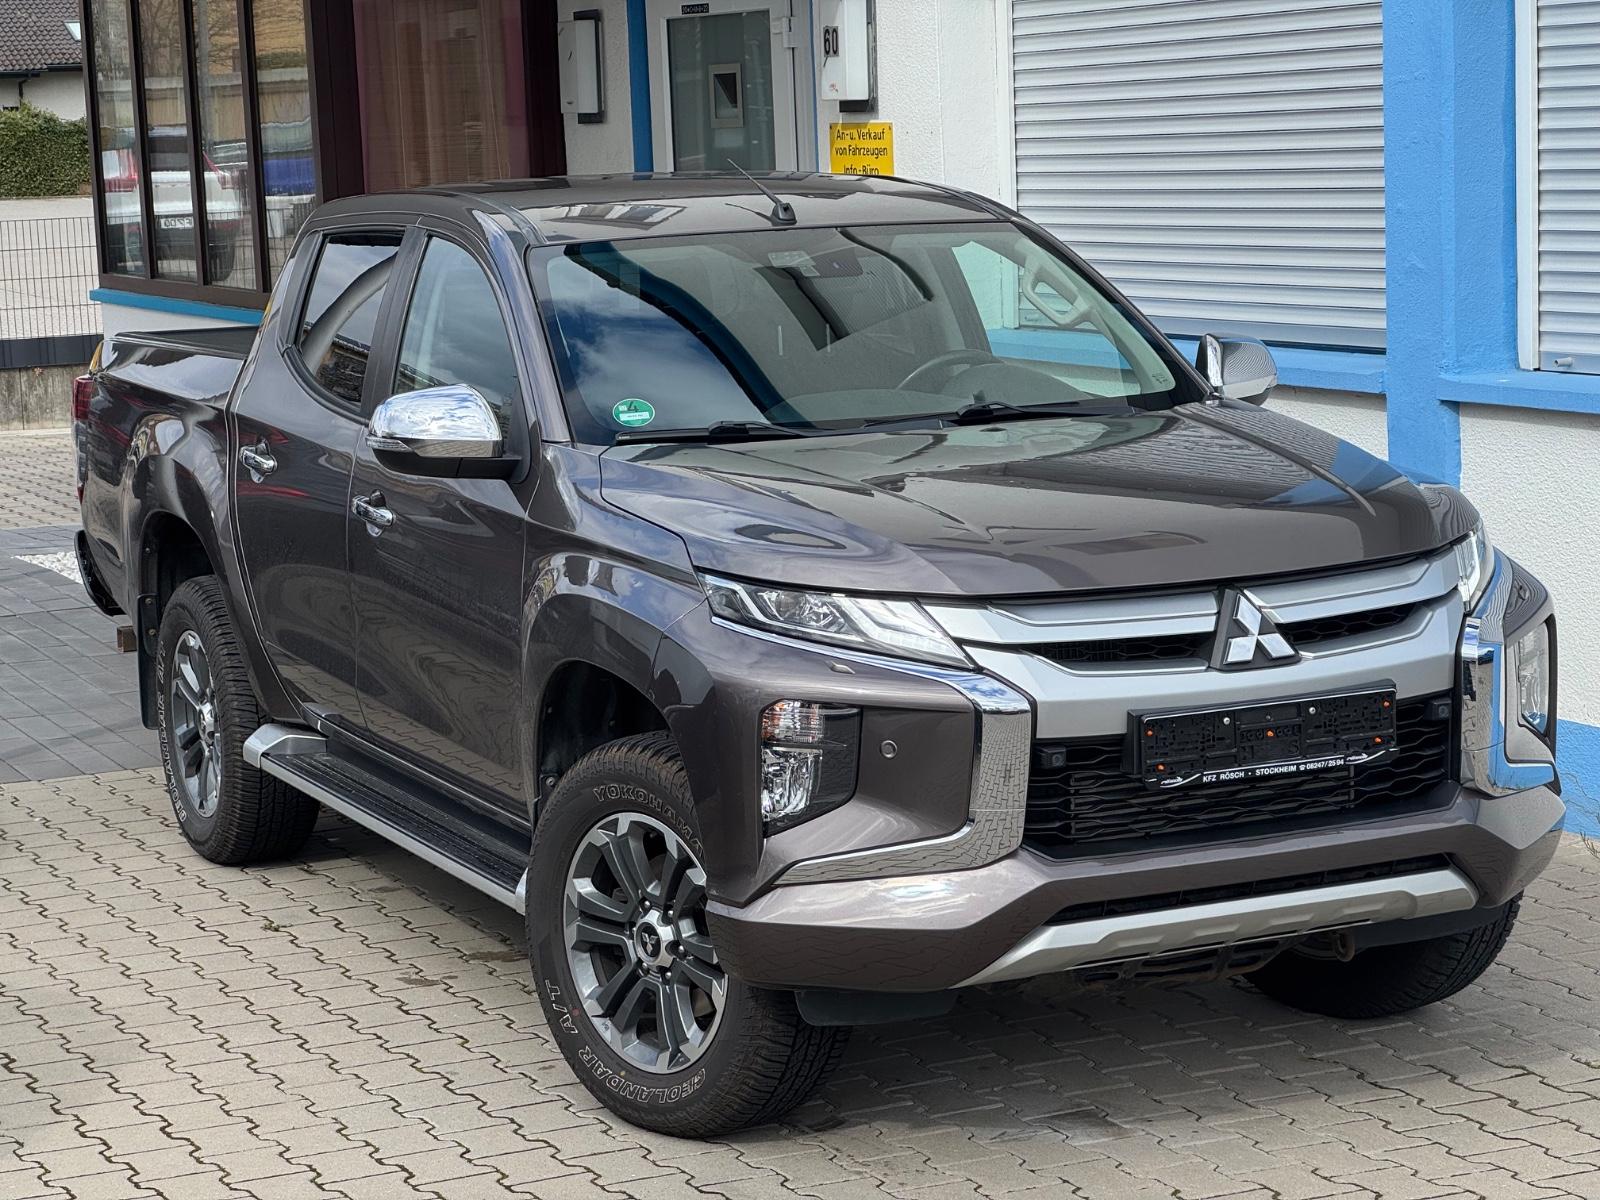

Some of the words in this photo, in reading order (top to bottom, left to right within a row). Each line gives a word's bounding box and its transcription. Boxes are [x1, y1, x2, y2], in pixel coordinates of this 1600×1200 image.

[823, 28, 839, 55] 60
[856, 127, 885, 140] Verkauf
[835, 147, 848, 156] von
[848, 144, 888, 159] Fahrzeugen
[1202, 774, 1217, 783] KFZ
[1219, 770, 1245, 781] RÖSCH
[1255, 764, 1297, 777] STOCKHEIM
[592, 783, 704, 857] YOKOHAMA
[544, 979, 578, 1034] A/T
[578, 1045, 706, 1104] GEOLANDAR
